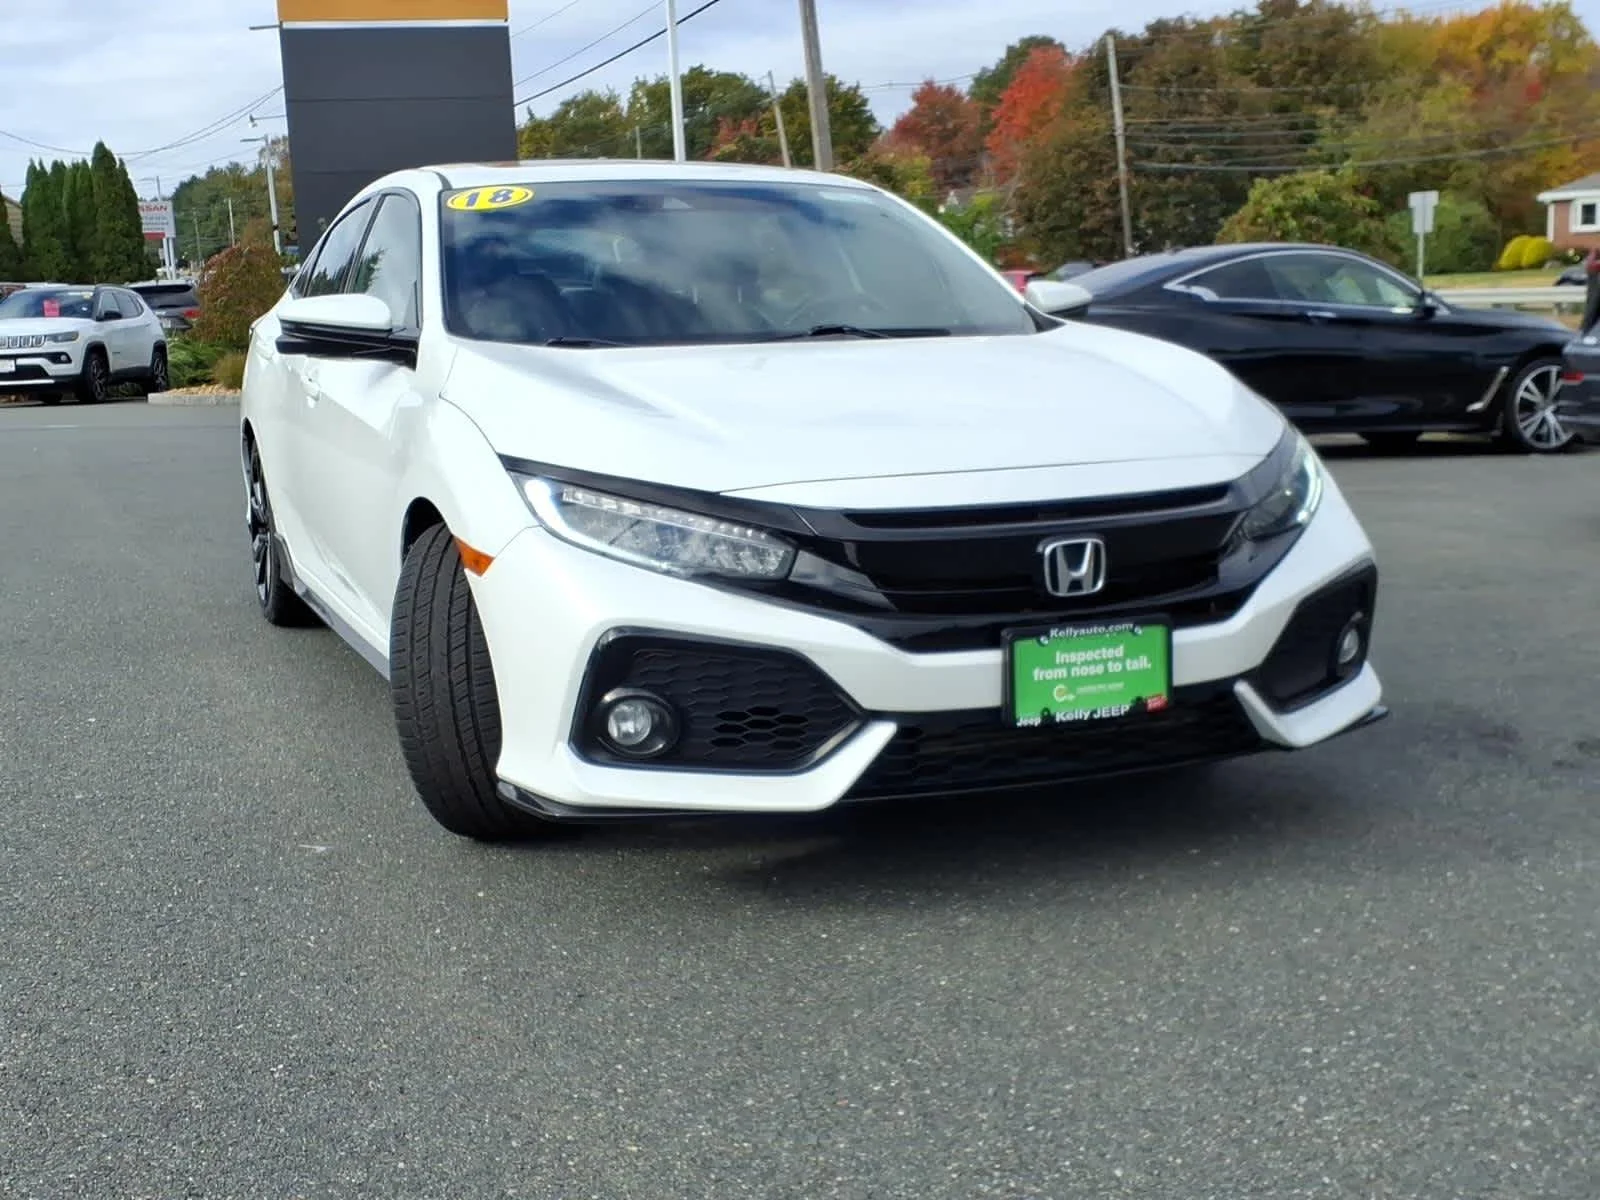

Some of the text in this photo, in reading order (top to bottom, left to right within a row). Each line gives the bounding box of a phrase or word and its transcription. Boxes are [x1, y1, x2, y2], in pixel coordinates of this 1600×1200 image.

[465, 189, 515, 208] 18
[1049, 623, 1134, 639] Kellyauto.com
[1055, 645, 1125, 665] Inspected
[1033, 655, 1152, 681] from nose to tail.
[1055, 709, 1091, 723] Kelly
[1093, 703, 1131, 719] JEEP
